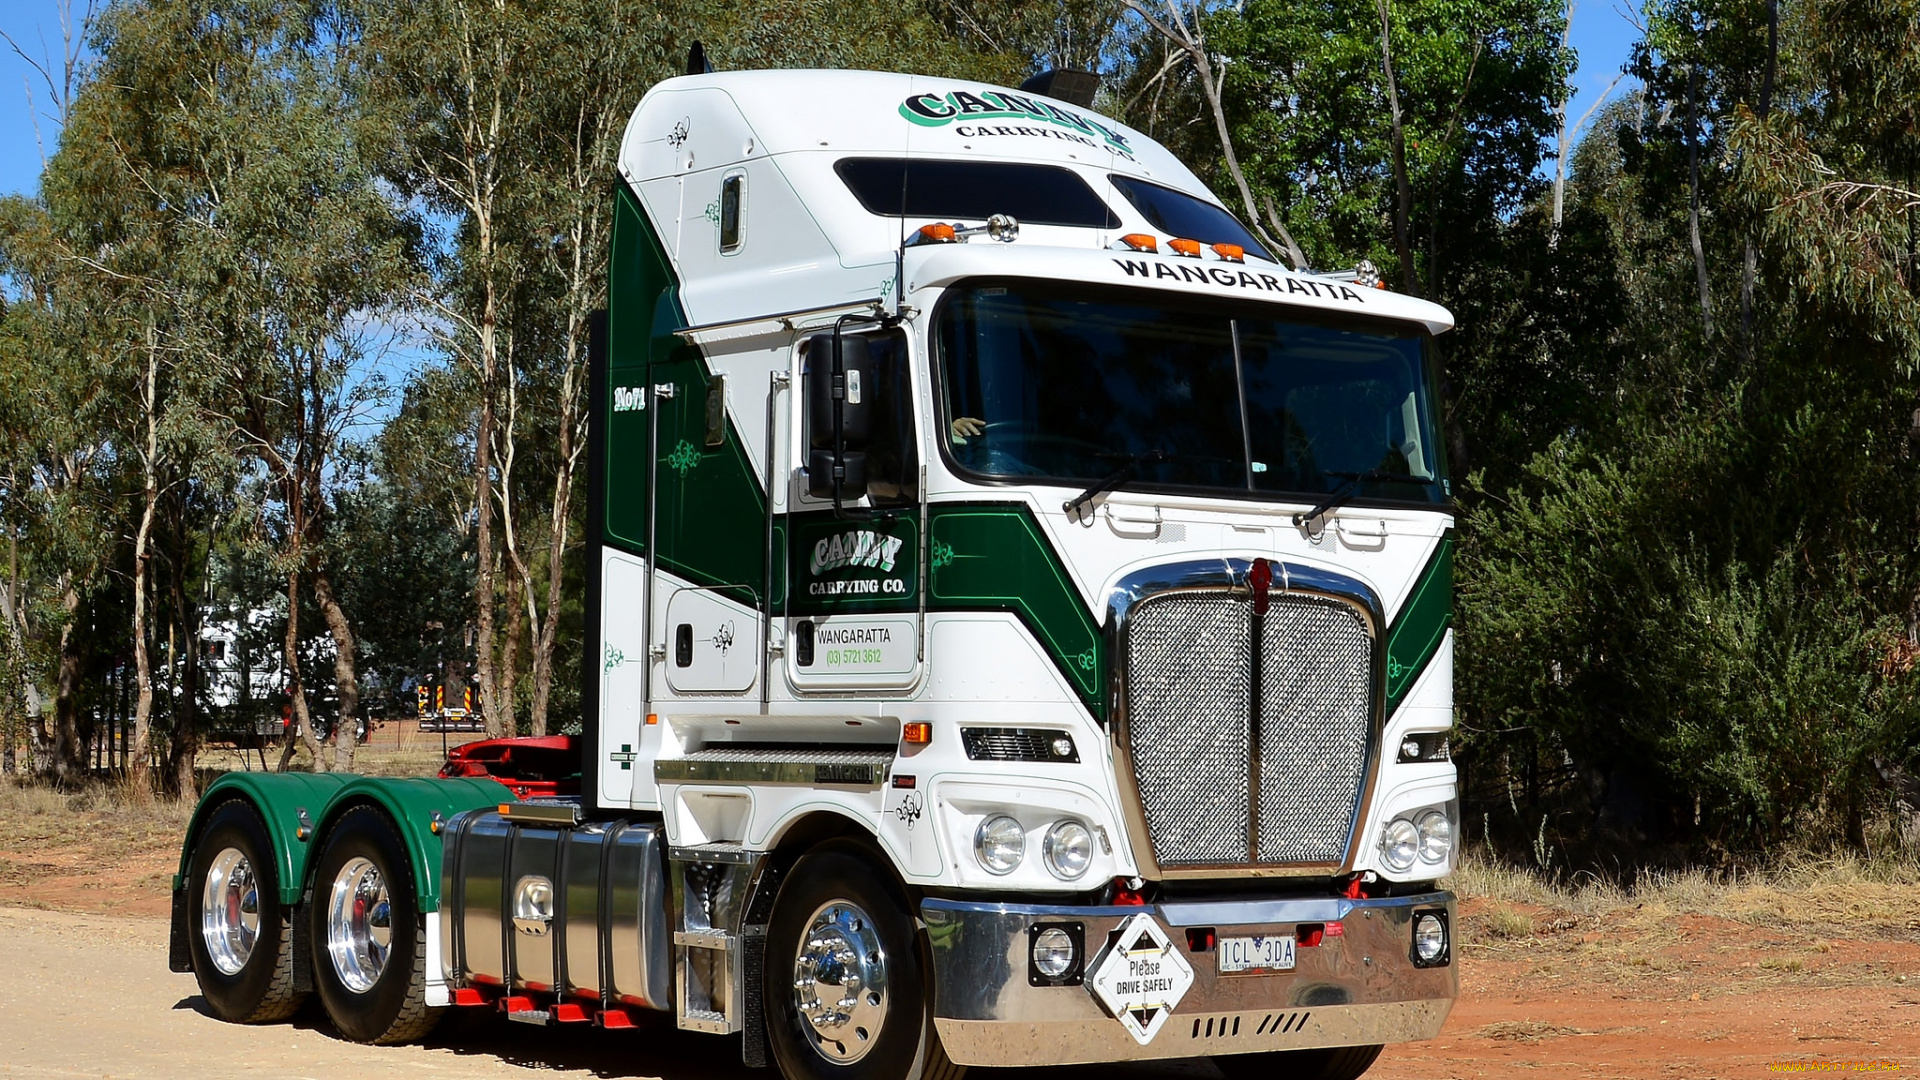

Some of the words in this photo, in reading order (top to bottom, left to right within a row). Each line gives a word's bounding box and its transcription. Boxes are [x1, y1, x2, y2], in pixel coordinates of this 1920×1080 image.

[899, 91, 1133, 153] CANNY
[956, 126, 1097, 148] CARRYING
[1103, 144, 1142, 165] CO.
[1111, 258, 1365, 303] WANGARATTA
[810, 530, 903, 576] CANNY
[809, 579, 879, 595] CARRYING
[882, 578, 906, 593] CO.
[818, 628, 891, 644] WANGARATTA
[826, 650, 841, 667] (03)
[843, 650, 861, 664] 5721
[863, 649, 881, 663] 3612
[1130, 960, 1160, 976] Please
[1116, 980, 1141, 994] DRIVE
[1143, 977, 1173, 992] SAFELY
